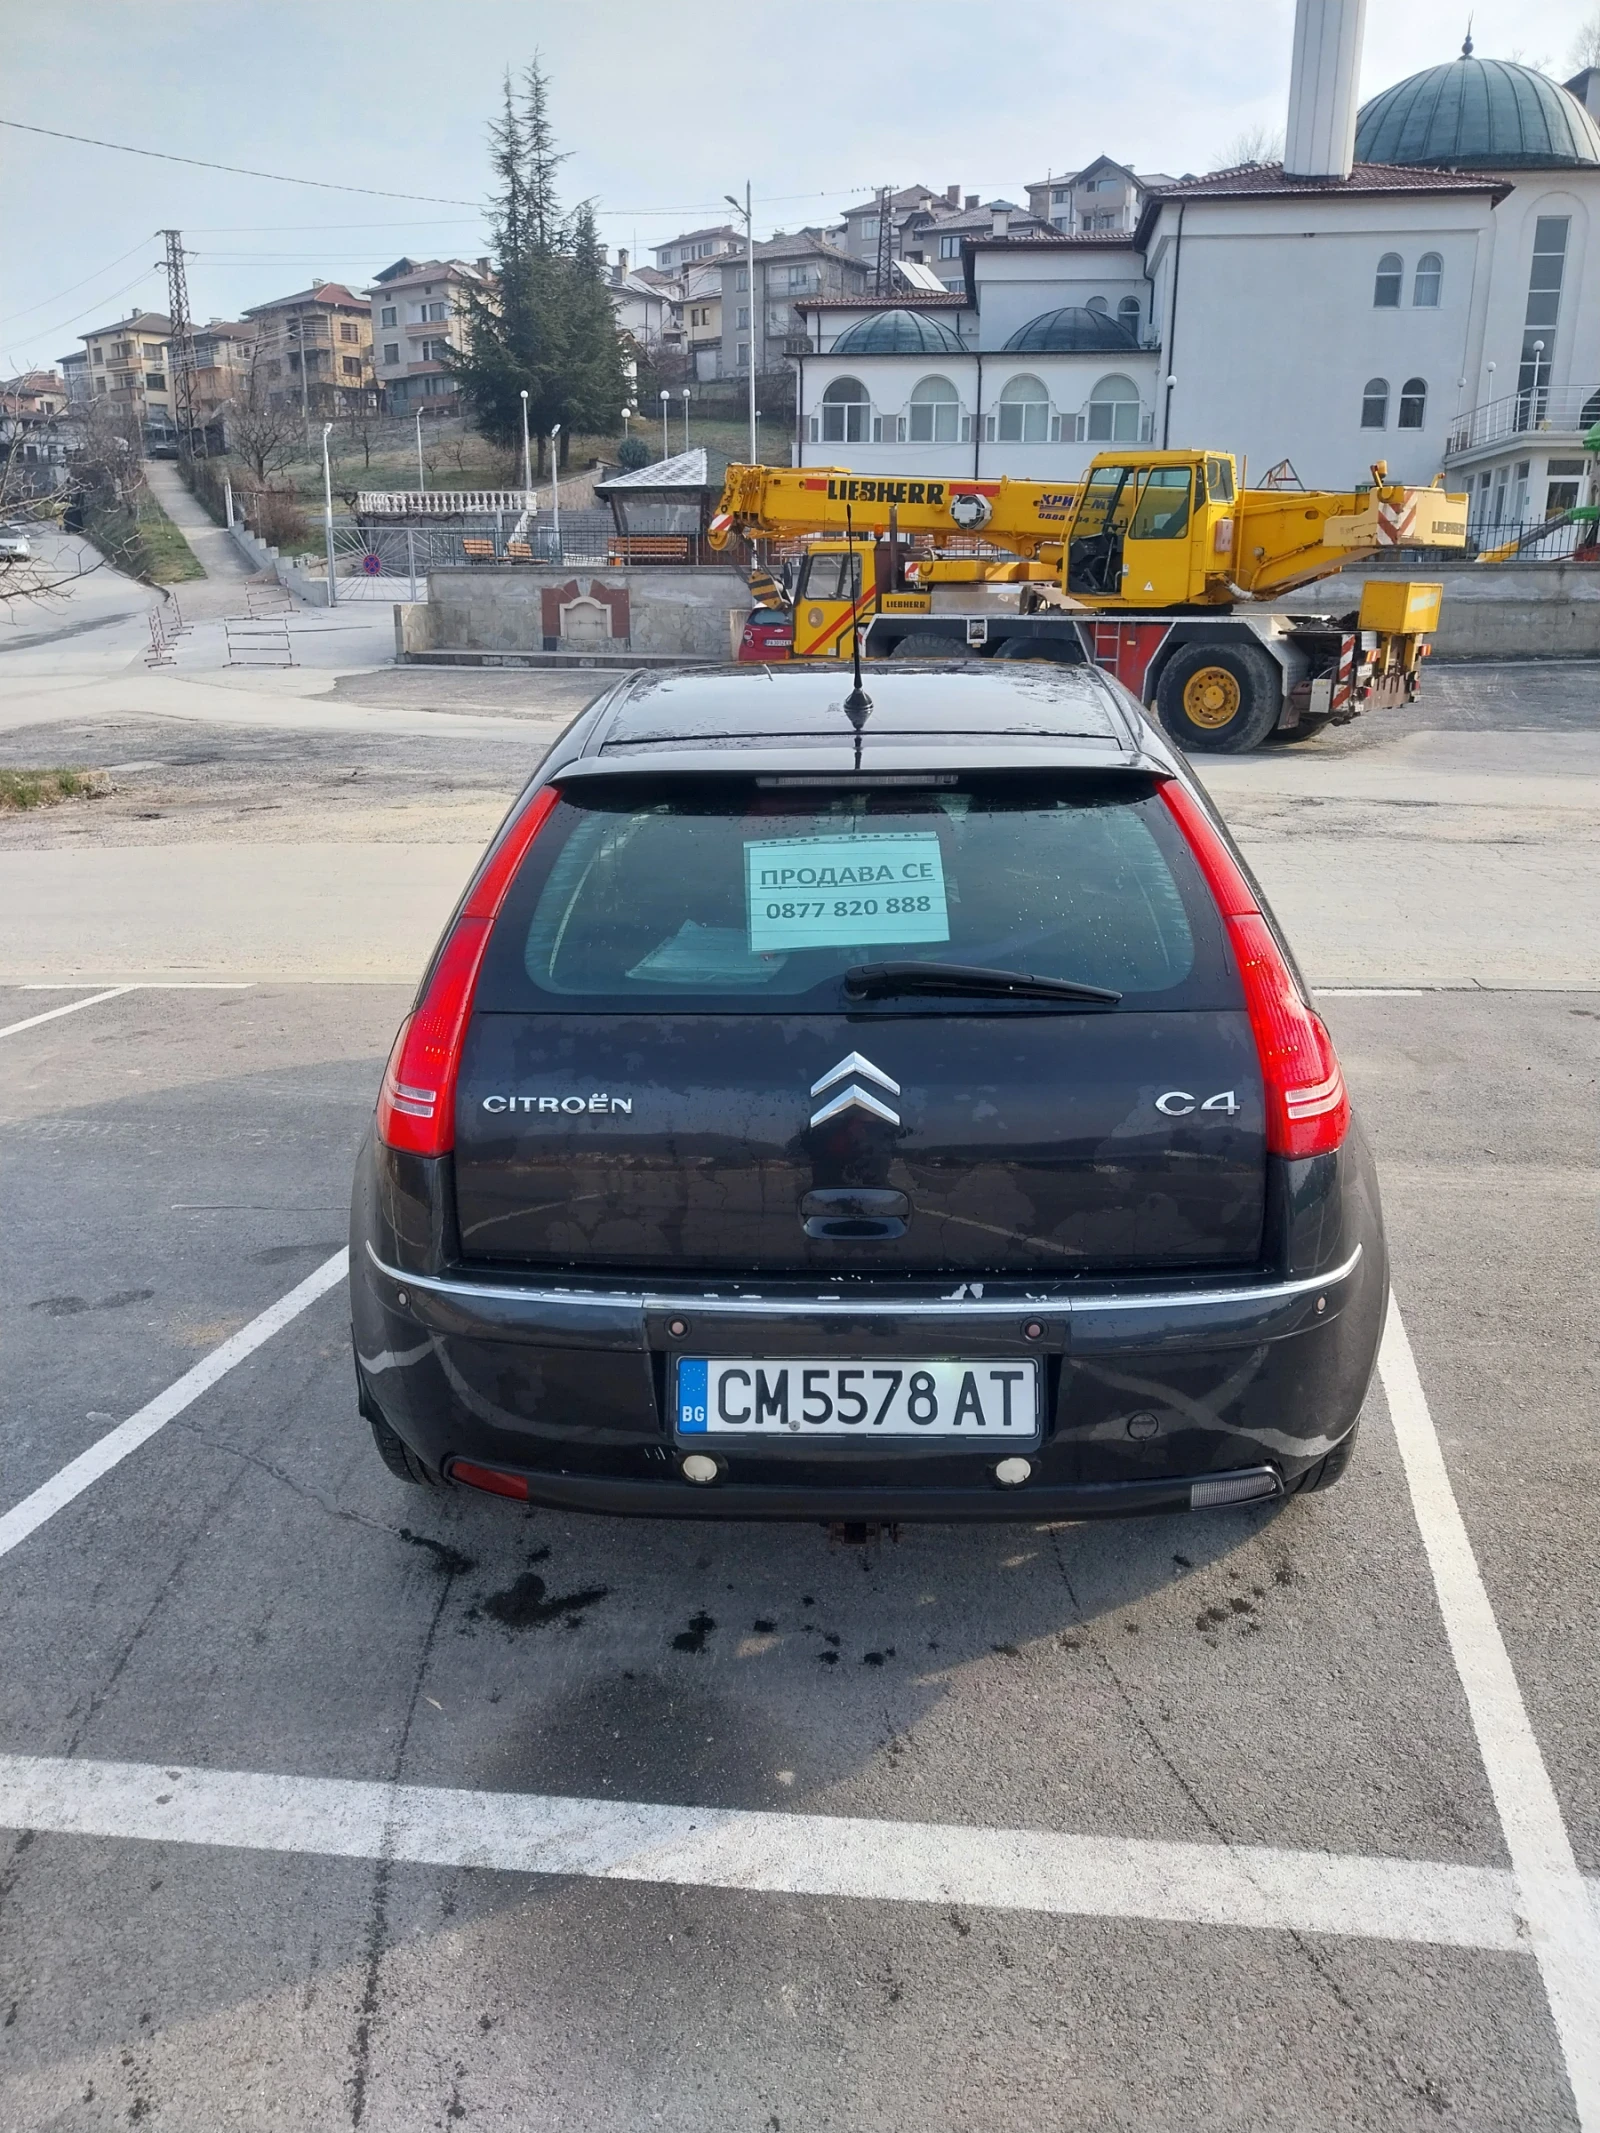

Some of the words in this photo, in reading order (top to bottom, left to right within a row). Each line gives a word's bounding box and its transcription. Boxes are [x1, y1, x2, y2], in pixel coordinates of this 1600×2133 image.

[828, 480, 944, 505] LIEBHERR
[760, 865, 894, 887] ПРОДАВА
[902, 863, 933, 879] СЕ
[766, 902, 825, 919] 0877
[833, 899, 878, 917] 820
[886, 896, 931, 914] 888
[482, 1093, 632, 1113] CITROËN
[1155, 1091, 1240, 1115] C4
[682, 1405, 705, 1422] BG
